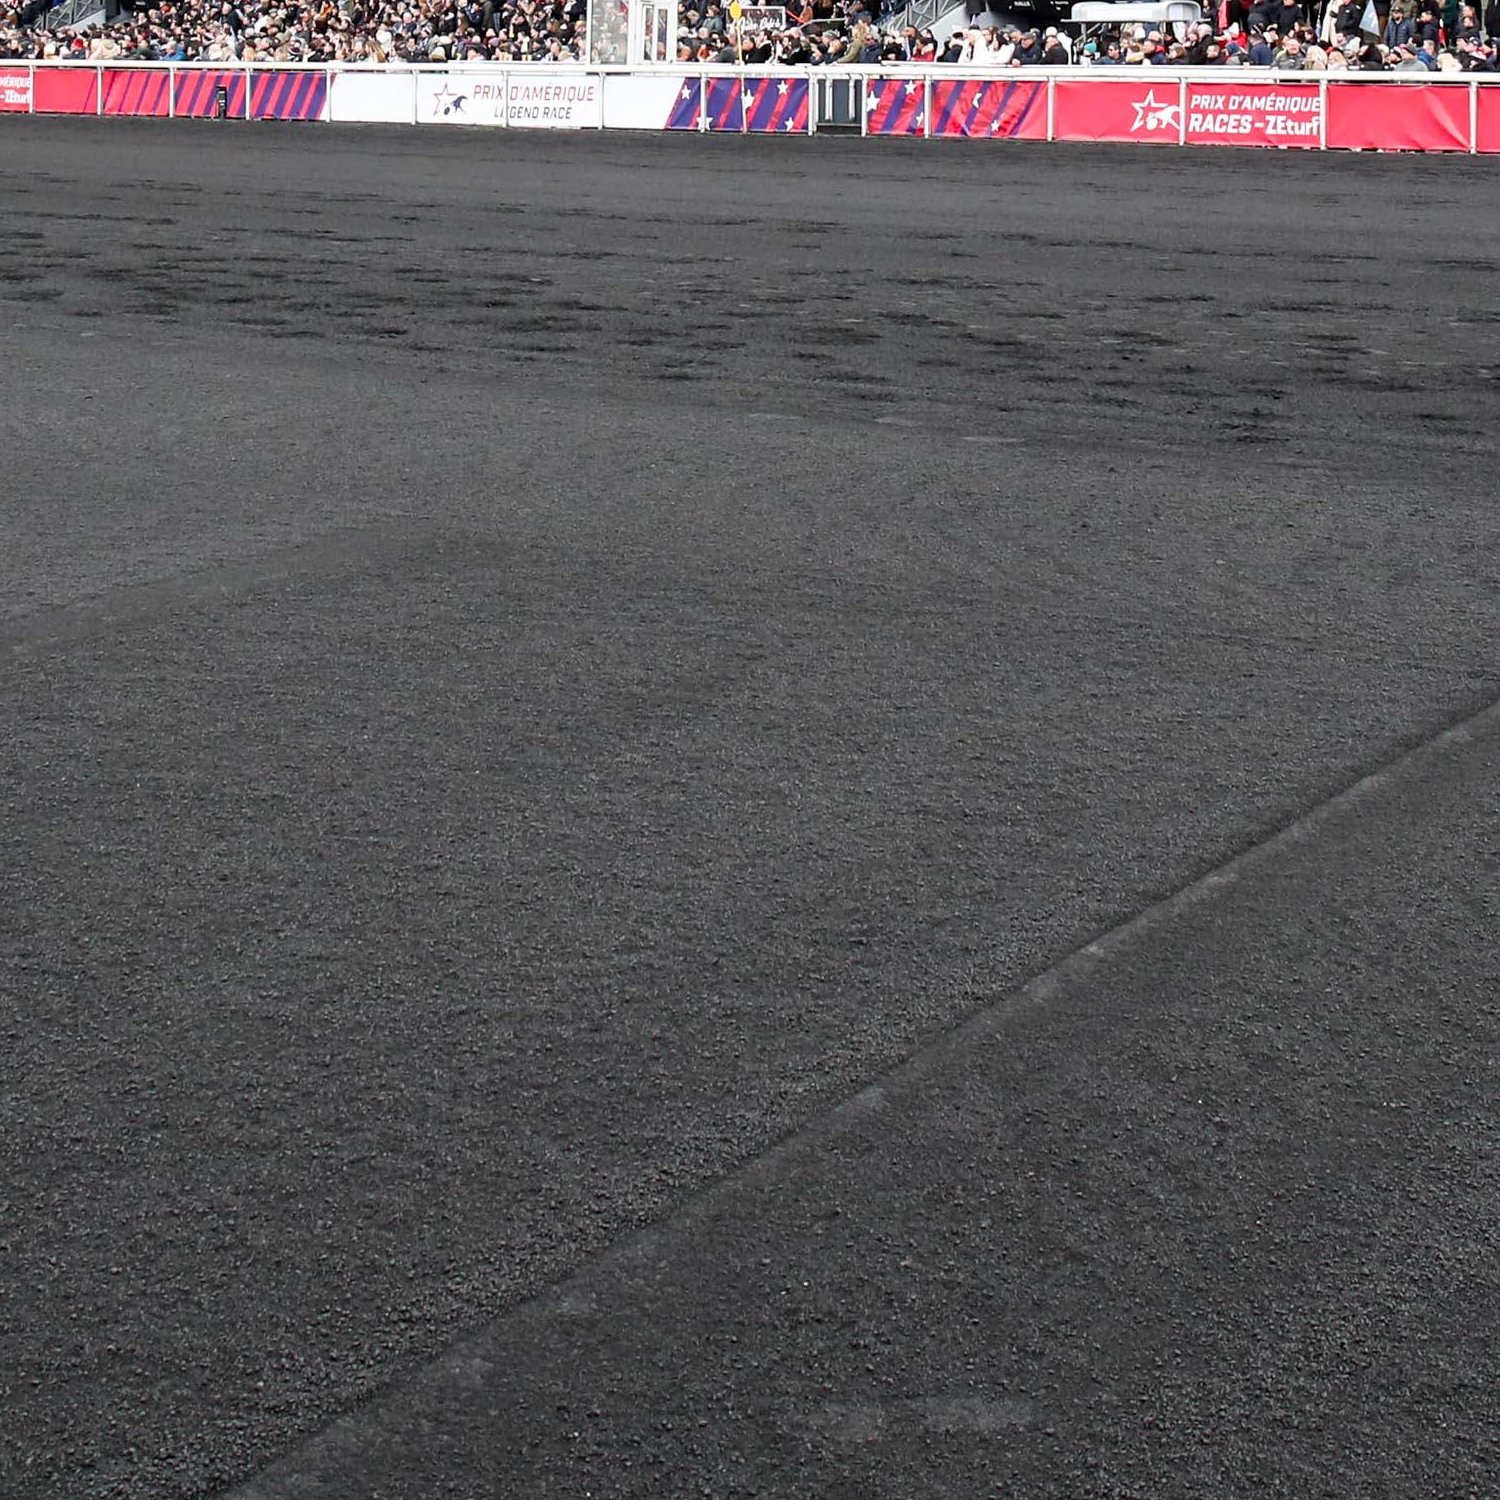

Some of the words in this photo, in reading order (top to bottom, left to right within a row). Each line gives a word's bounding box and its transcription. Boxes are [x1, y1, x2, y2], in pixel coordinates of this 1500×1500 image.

[473, 84, 504, 100] PRIX
[509, 81, 595, 103] D'AMÉRIQUE
[1190, 94, 1226, 110] PRIX
[1228, 92, 1321, 114] D'AMÉRIQUE
[542, 106, 573, 120] RACE
